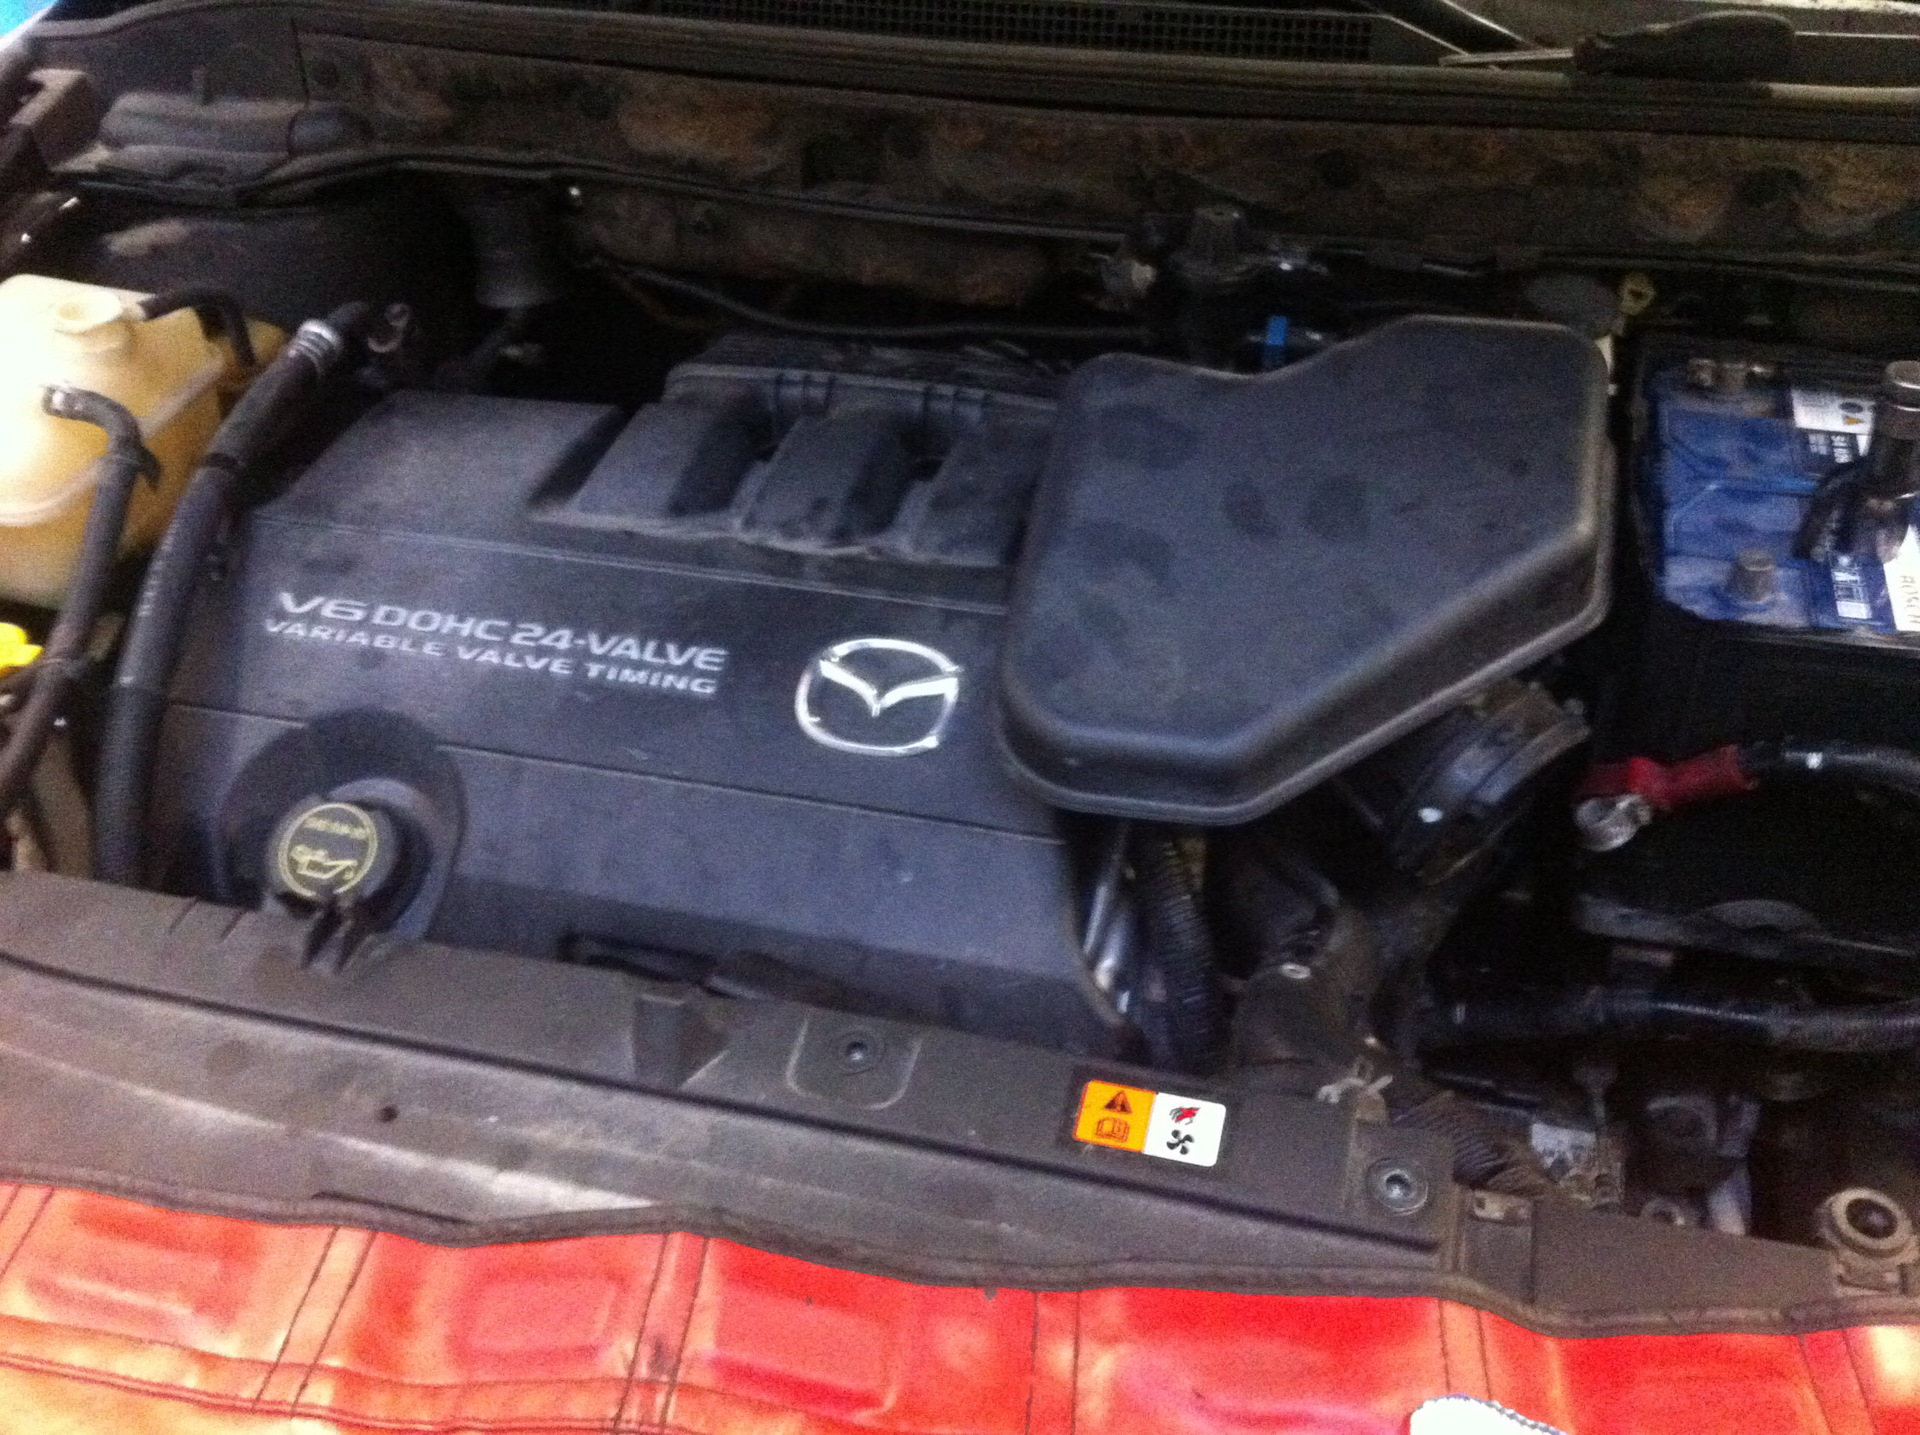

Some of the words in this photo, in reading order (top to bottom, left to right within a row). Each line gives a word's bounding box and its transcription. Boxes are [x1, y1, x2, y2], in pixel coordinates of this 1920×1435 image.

[265, 618, 446, 657] VARIABLE
[456, 645, 573, 675] VALVE
[585, 662, 717, 694] TIMING
[279, 592, 367, 622] V6
[372, 604, 511, 641] DOHC
[509, 622, 729, 672] 24-VALVE
